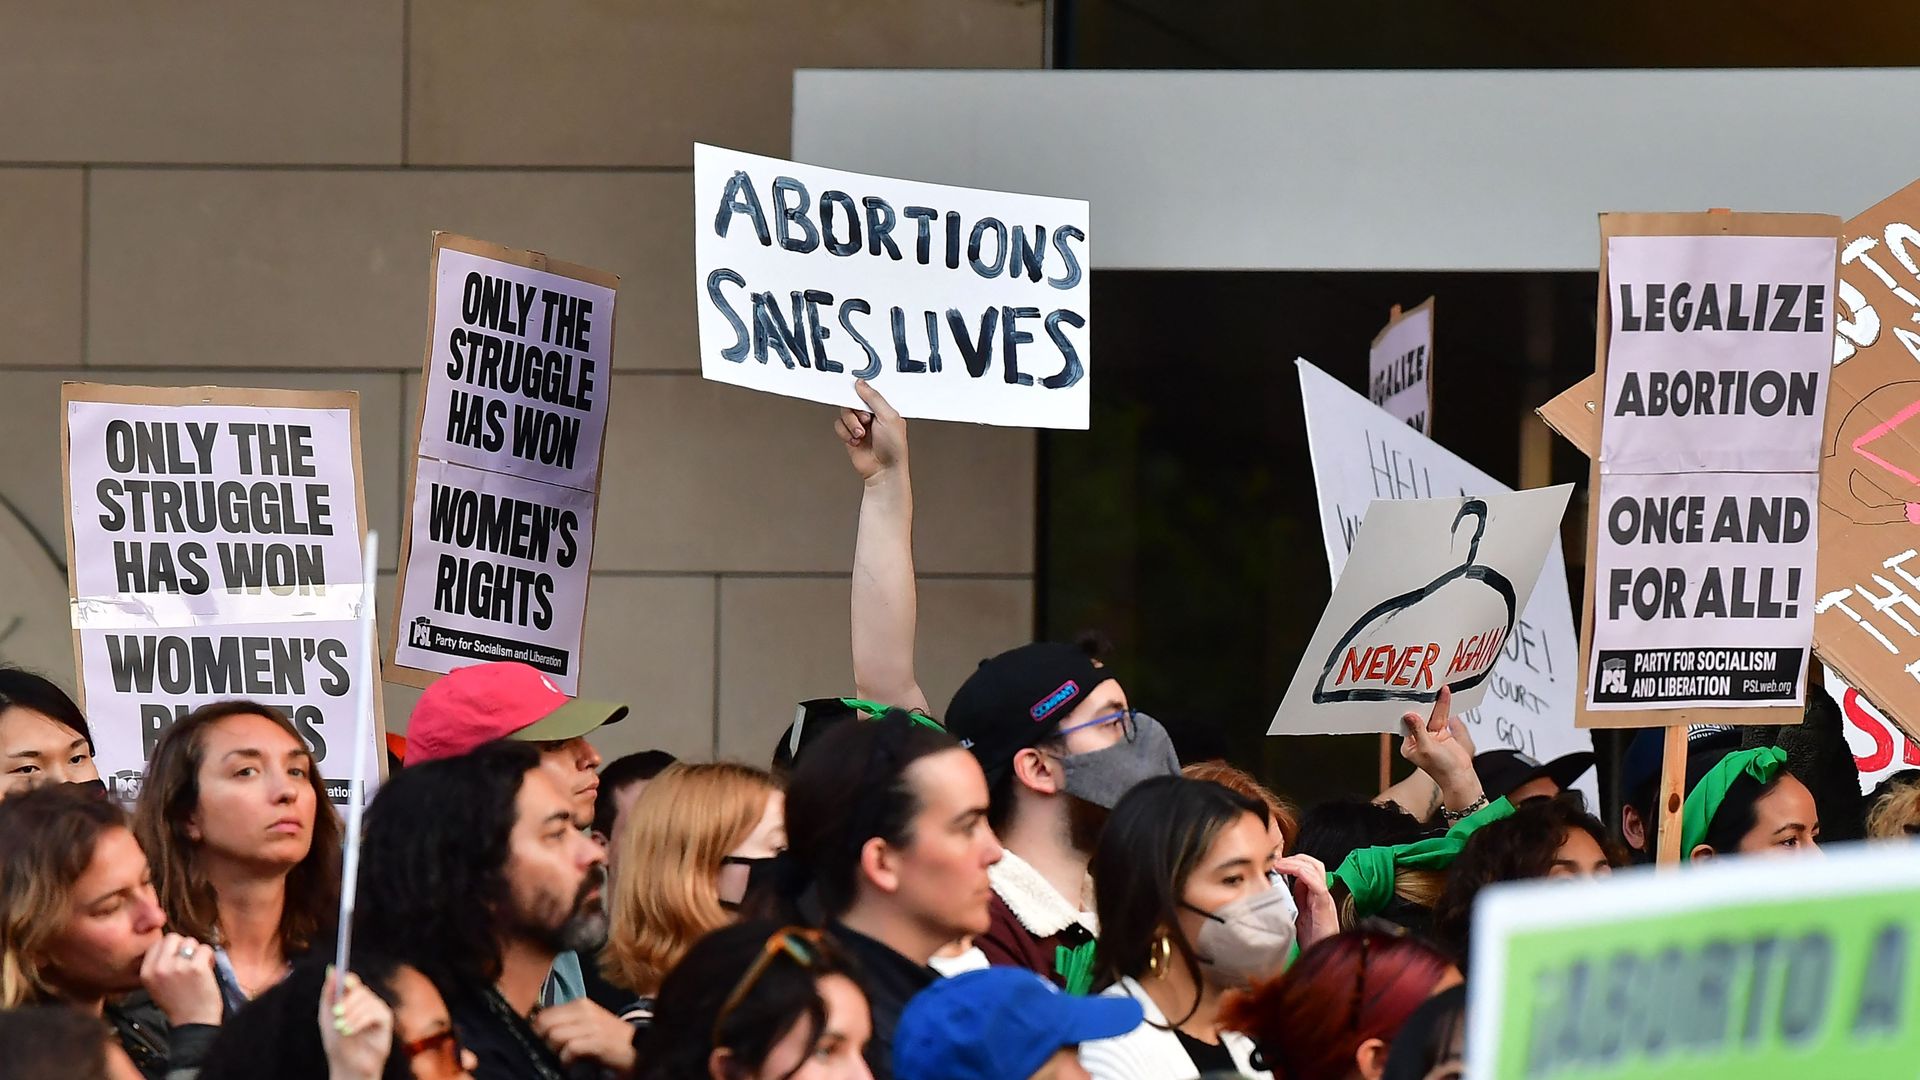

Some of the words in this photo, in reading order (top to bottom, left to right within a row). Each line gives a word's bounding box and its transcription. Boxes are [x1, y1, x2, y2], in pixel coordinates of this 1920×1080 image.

[714, 169, 1085, 291] ABORTIONS
[462, 271, 537, 337] ONLY
[538, 290, 593, 353] THE
[1620, 282, 1824, 332] LEGALIZE
[446, 327, 595, 412] STRUGGLE
[890, 304, 1086, 390] LIVES
[1614, 369, 1817, 417] ABORTION
[105, 420, 219, 474] ONLY
[229, 423, 317, 476] THE
[446, 389, 507, 453] HAS
[511, 405, 580, 470] WON
[97, 479, 334, 536] STRUGGLE
[429, 482, 578, 569] WOMEN'S
[1608, 496, 1703, 546] ONCE
[1710, 496, 1810, 544] AND
[113, 540, 209, 595] HAS
[218, 543, 327, 597] WON
[434, 553, 555, 632] RIGHTS
[1608, 566, 1688, 621] FOR
[1694, 567, 1802, 619] ALL!
[106, 634, 351, 697] WOMEN'S
[412, 623, 431, 647] PSL
[435, 633, 457, 651] Party
[458, 637, 472, 650] for
[473, 640, 513, 657] Socialism
[514, 649, 529, 660] and
[529, 650, 562, 668] Liberation
[1335, 643, 1441, 689] NEVER
[1445, 625, 1507, 678] AGAIN
[1600, 669, 1628, 693] PSL
[1634, 651, 1671, 672] PARTY
[1673, 651, 1695, 671] FOR
[1697, 651, 1777, 671] SOCIALISM
[1631, 677, 1656, 698] AND
[1658, 676, 1731, 697] LIBERATION
[1742, 679, 1792, 695] PSLweb.org
